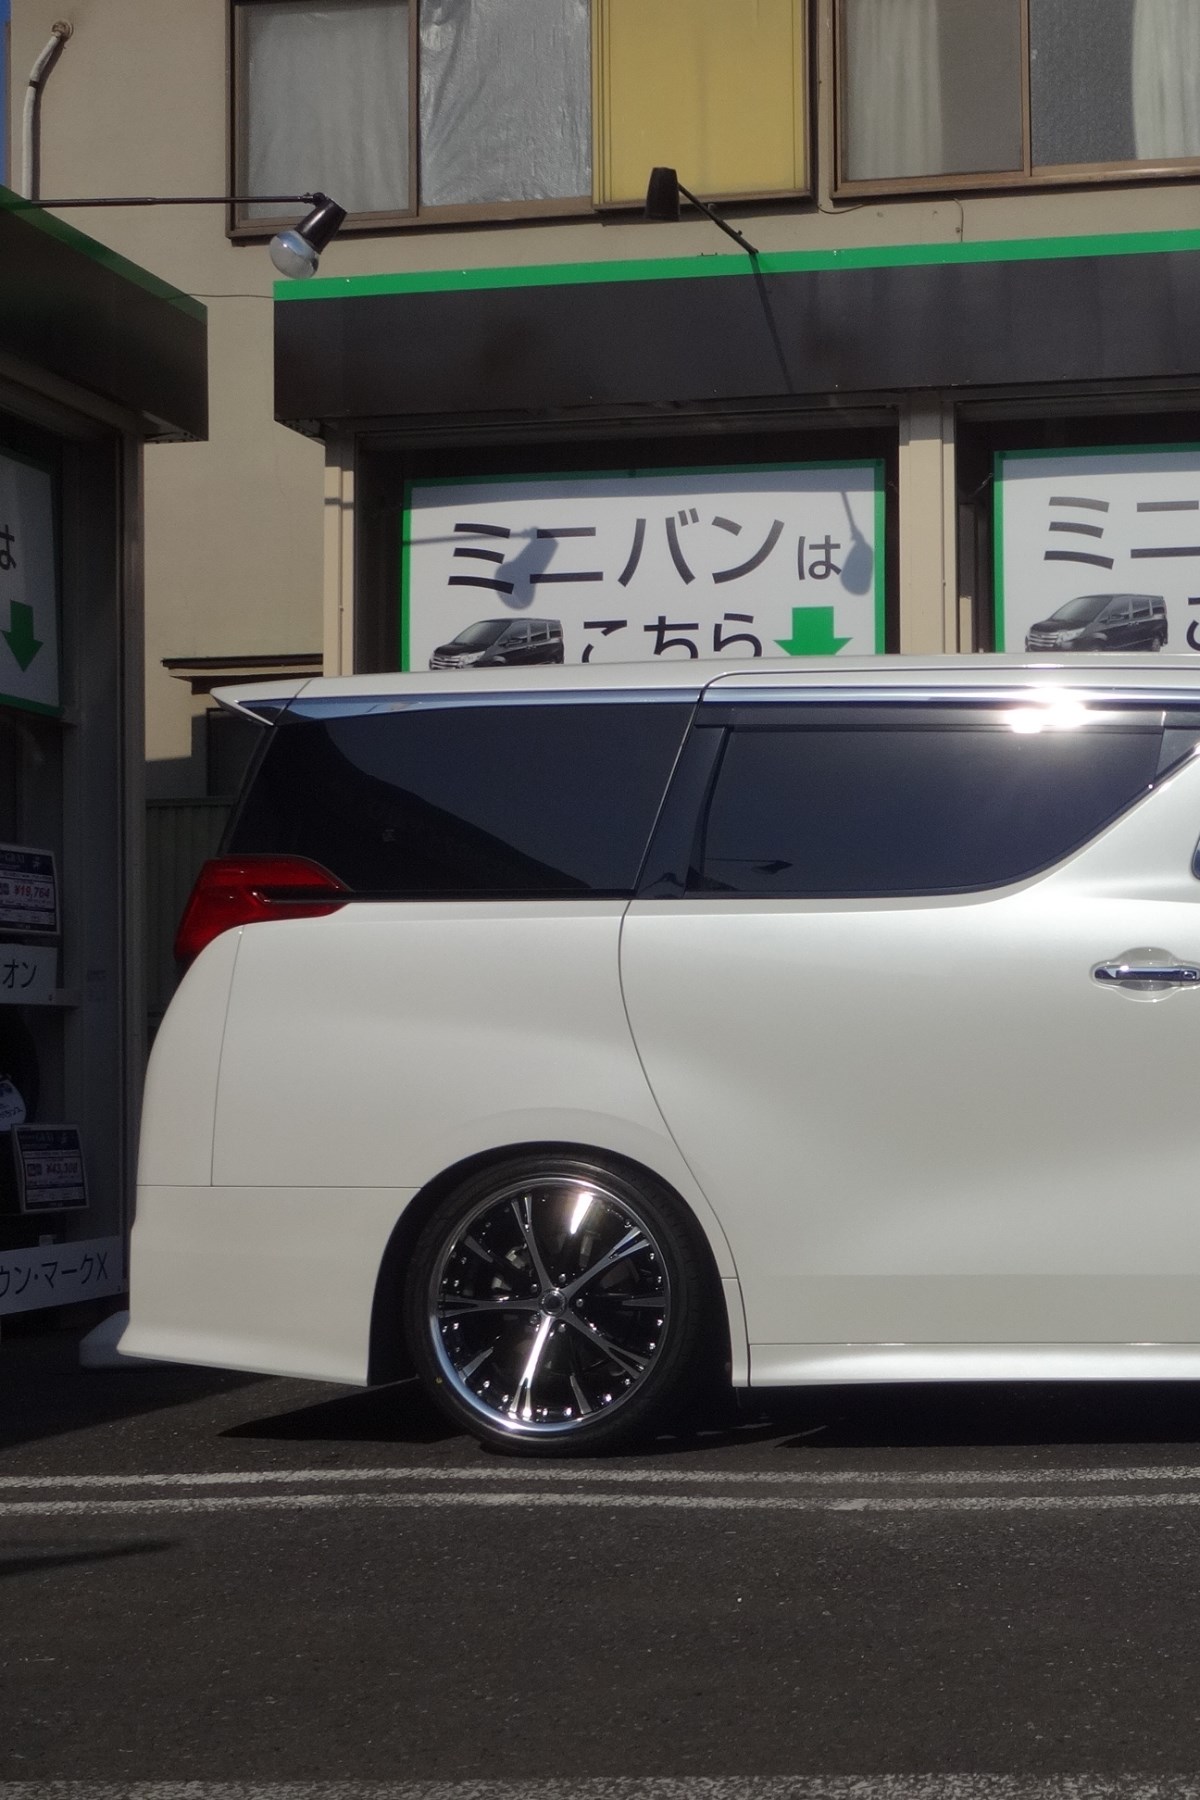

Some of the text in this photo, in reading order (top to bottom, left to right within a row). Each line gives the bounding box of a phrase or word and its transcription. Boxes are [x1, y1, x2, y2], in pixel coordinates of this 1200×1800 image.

[448, 508, 842, 594] ミニバンは
[582, 613, 763, 664] こちら
